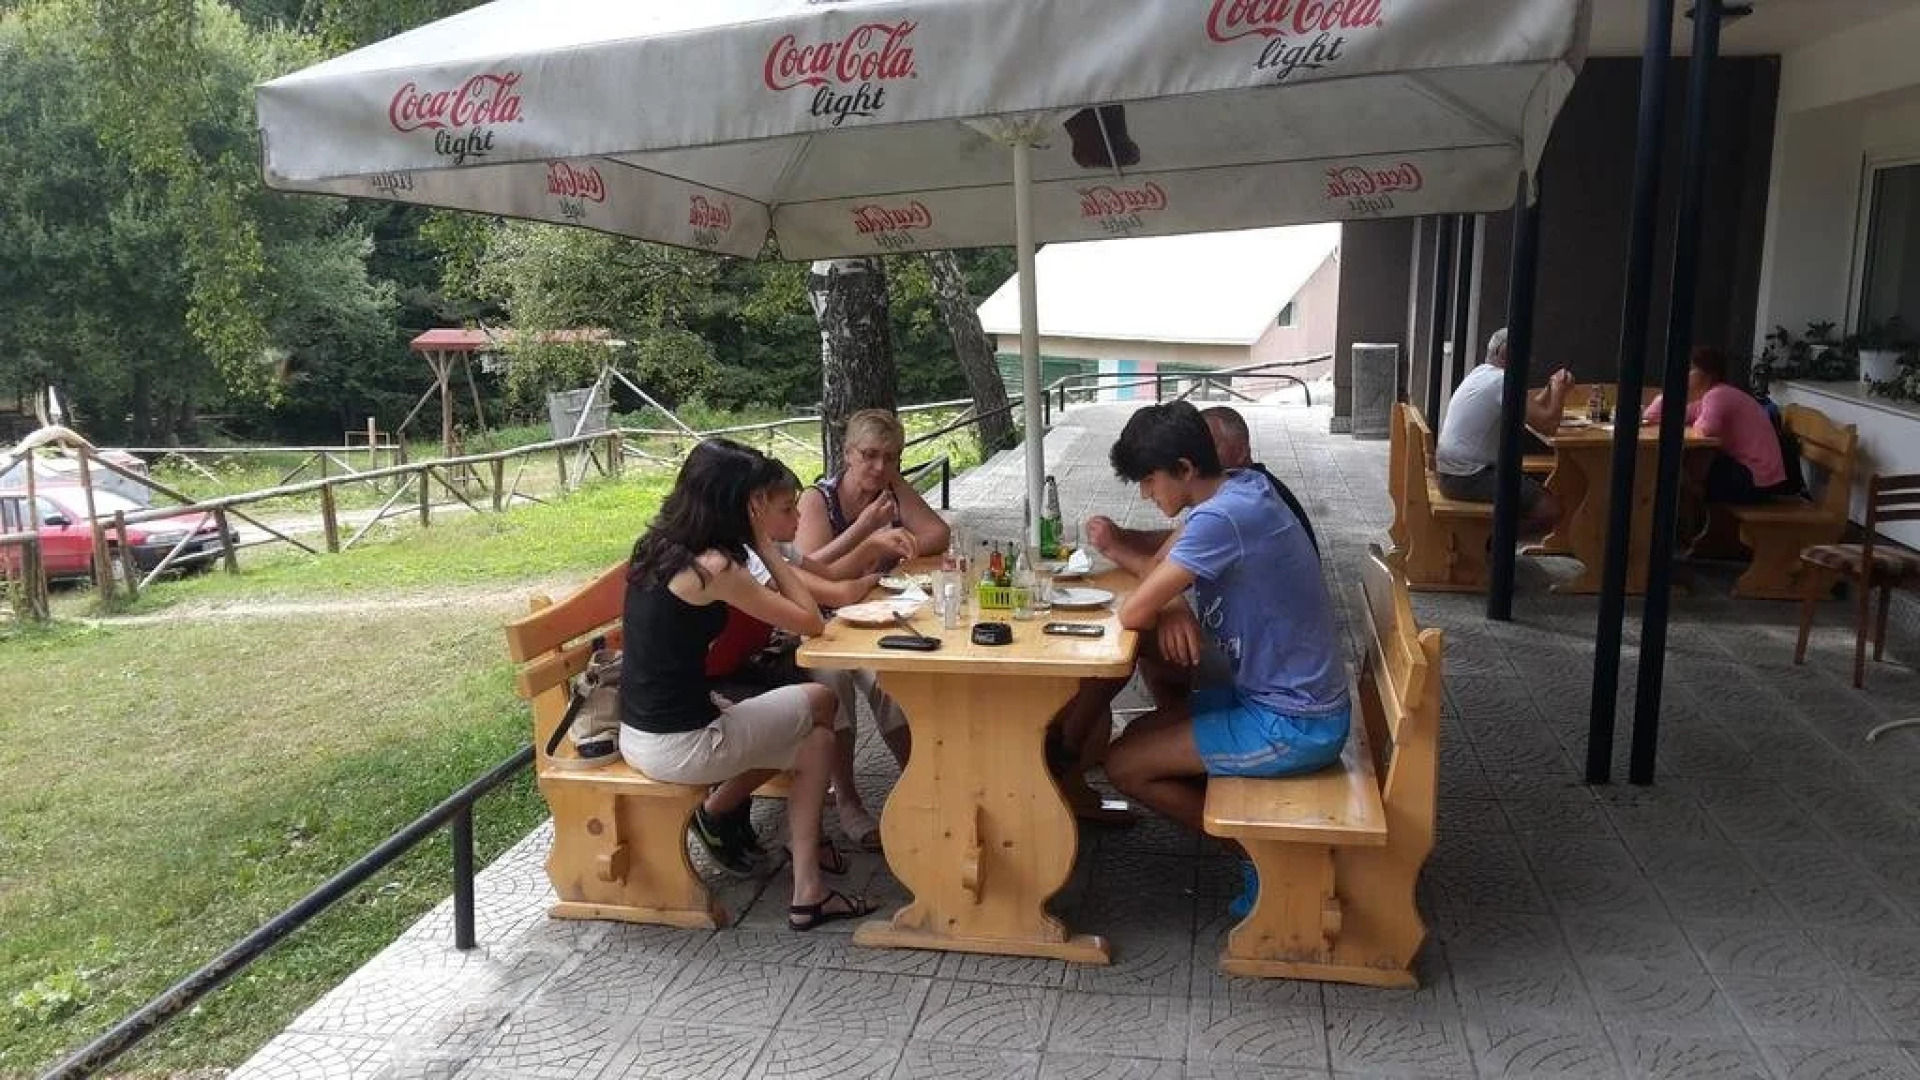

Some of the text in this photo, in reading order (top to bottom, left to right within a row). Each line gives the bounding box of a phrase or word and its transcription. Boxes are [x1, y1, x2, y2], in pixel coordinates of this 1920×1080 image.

[1207, 0, 1381, 42] CocaCoa
[764, 19, 917, 91] Coca-Cola
[1253, 32, 1346, 80] light
[389, 71, 523, 133] Coca-Cola
[809, 82, 885, 126] light
[434, 127, 495, 165] light
